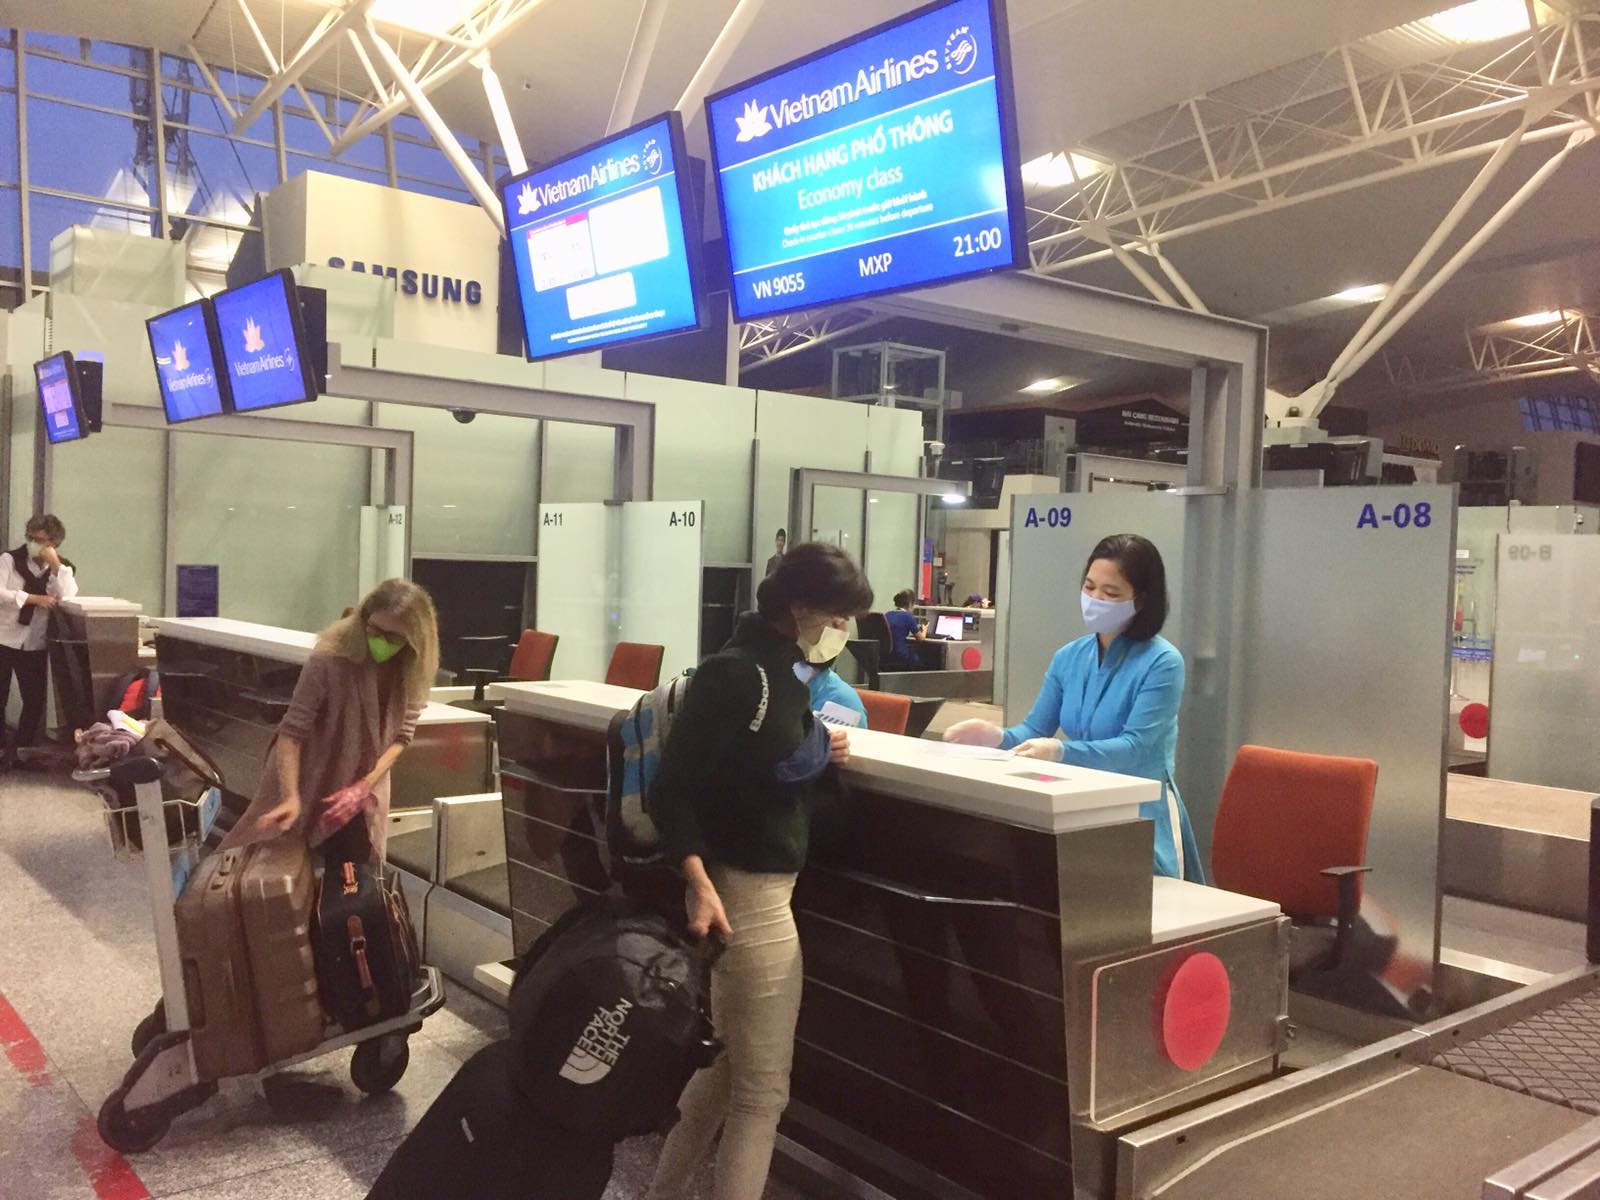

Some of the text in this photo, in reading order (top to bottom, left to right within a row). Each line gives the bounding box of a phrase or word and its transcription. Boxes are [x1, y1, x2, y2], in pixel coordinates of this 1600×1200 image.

[752, 160, 801, 192] KHÁCH
[889, 109, 954, 149] THÔNG
[797, 165, 904, 210] Economy class
[953, 227, 1002, 257] 21:00
[858, 252, 893, 278] MXP
[752, 272, 805, 300] VN 9055
[543, 512, 563, 526] A-11
[669, 511, 695, 527] A-10
[1025, 507, 1072, 528] A-09
[1356, 502, 1432, 529] A-08
[577, 1006, 611, 1051] FACE
[586, 997, 633, 1061] NORTH
[602, 1035, 631, 1066] THE
